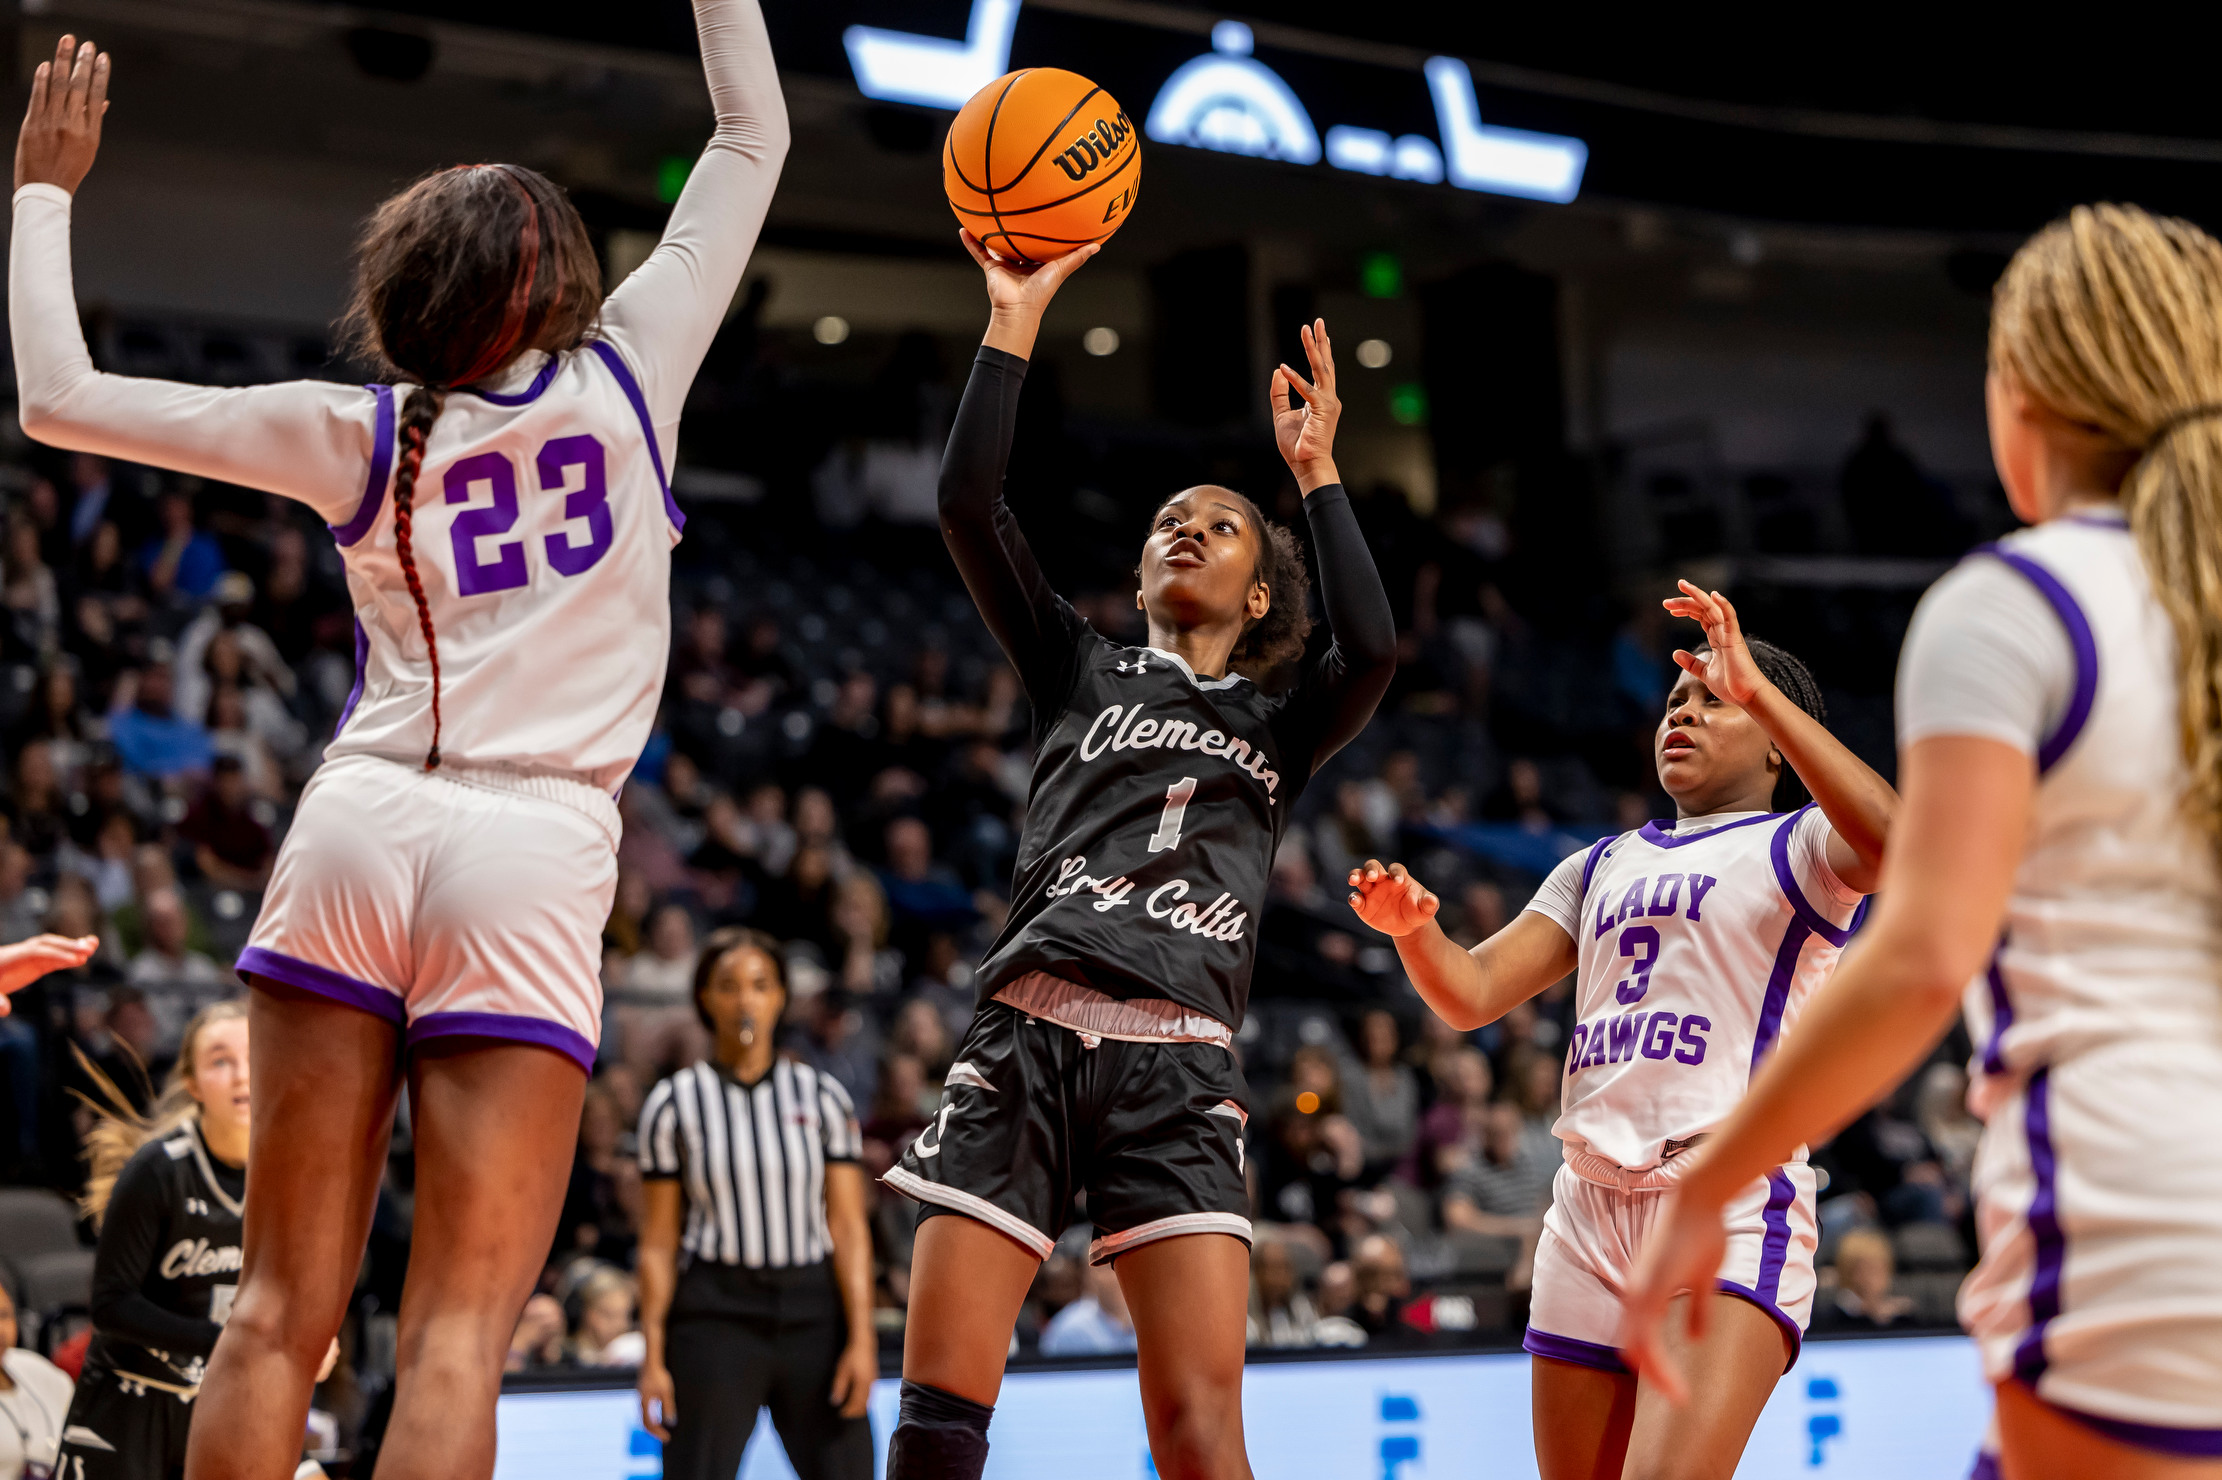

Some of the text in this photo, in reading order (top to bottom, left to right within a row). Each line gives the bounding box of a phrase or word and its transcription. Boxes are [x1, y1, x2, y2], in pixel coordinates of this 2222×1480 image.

[1052, 108, 1132, 181] Wilso
[1102, 173, 1139, 224] EV
[443, 433, 614, 597] 23
[1147, 777, 1197, 853] 1
[1146, 880, 1247, 941] Colts
[1595, 873, 1717, 942] LADY
[1615, 925, 1660, 1005] 3
[1569, 1011, 1712, 1077] DAWGS
[160, 1237, 245, 1280] Clem
